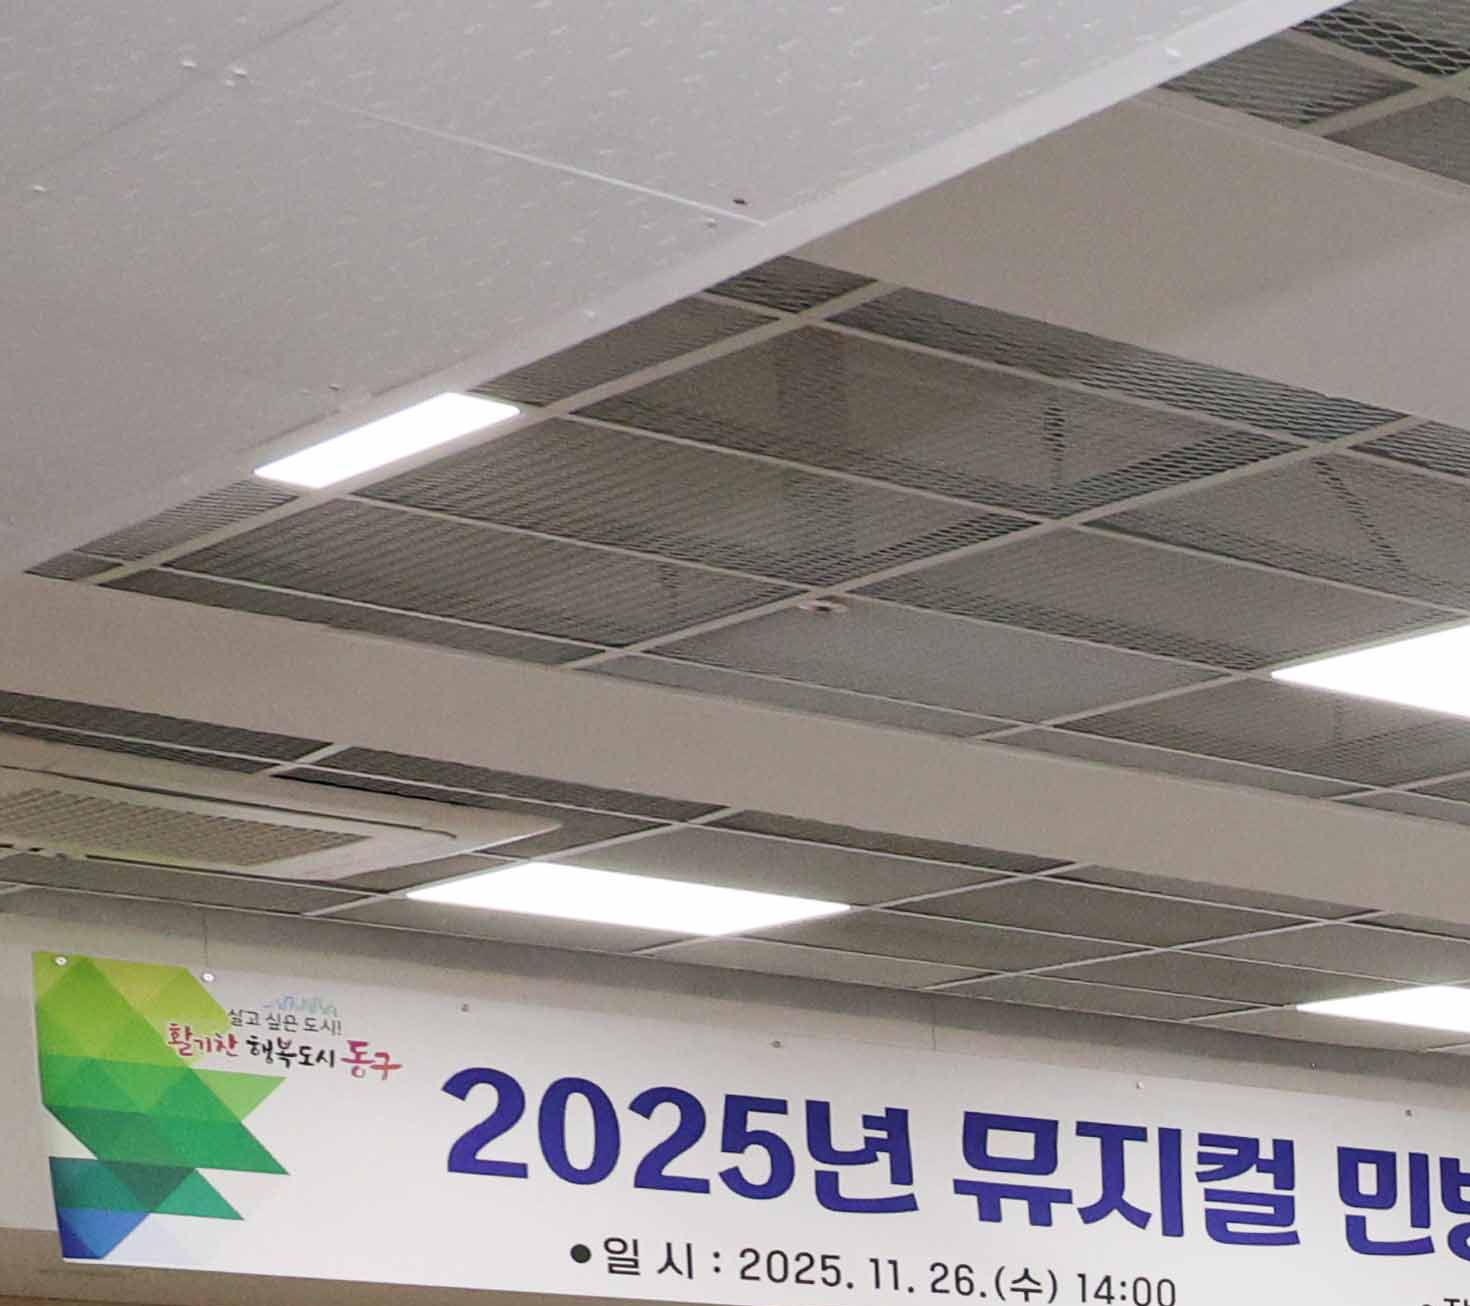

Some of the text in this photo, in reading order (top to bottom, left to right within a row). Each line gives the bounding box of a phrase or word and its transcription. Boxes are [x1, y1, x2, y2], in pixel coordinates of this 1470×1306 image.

[265, 1013, 298, 1033] 싶은
[303, 1017, 342, 1036] 도시!
[168, 1023, 403, 1081] 활기찬 행복도시 동구
[441, 1066, 919, 1214] 2025년
[952, 1110, 1301, 1246] 뮤지컬
[739, 1248, 854, 1289] 2025.
[869, 1257, 914, 1293] 11.
